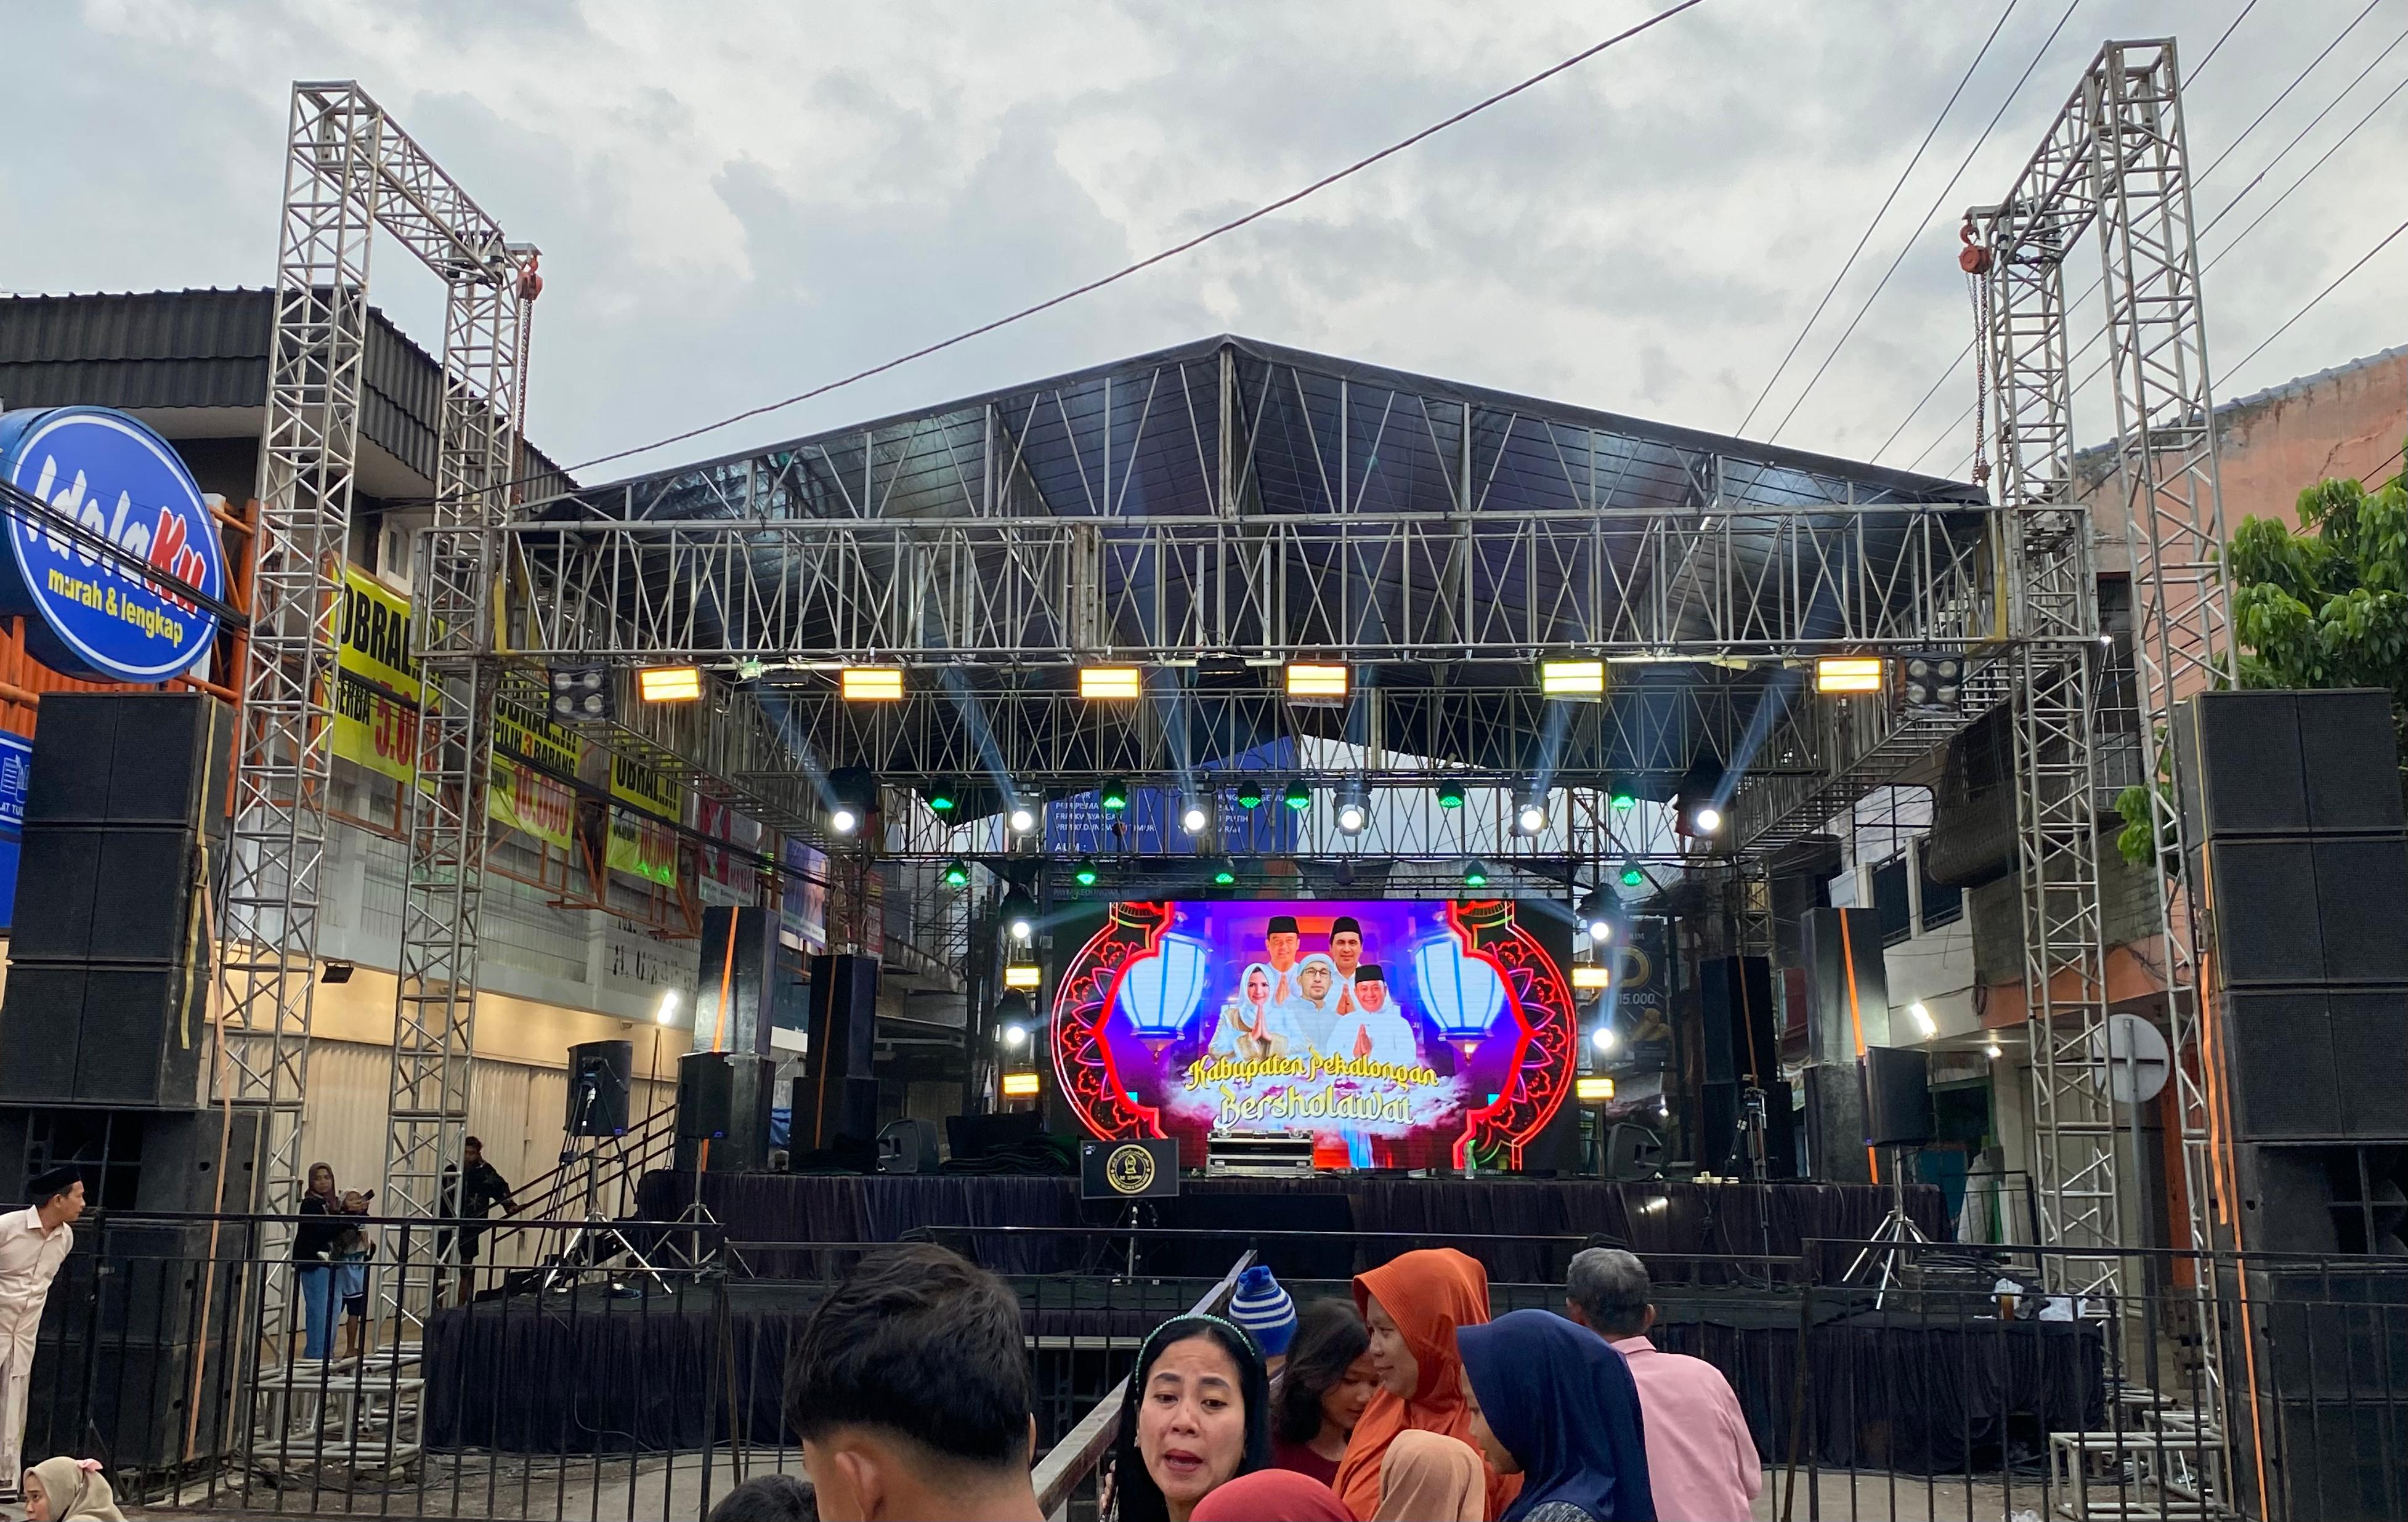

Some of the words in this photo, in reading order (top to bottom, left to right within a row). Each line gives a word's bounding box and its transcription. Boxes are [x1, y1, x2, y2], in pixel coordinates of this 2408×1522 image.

[26, 454, 207, 619] IdolaKu
[48, 568, 102, 611] murah
[105, 586, 118, 617] &
[121, 593, 184, 648] lengkap
[493, 718, 522, 753] PILIH
[524, 733, 533, 758] 3
[533, 739, 575, 776] BARANG
[514, 765, 570, 837] 10.000
[1184, 1053, 1307, 1091] Kabupaten
[1307, 1046, 1440, 1093] Pekalongan
[1213, 1082, 1416, 1131] Bersholawat
